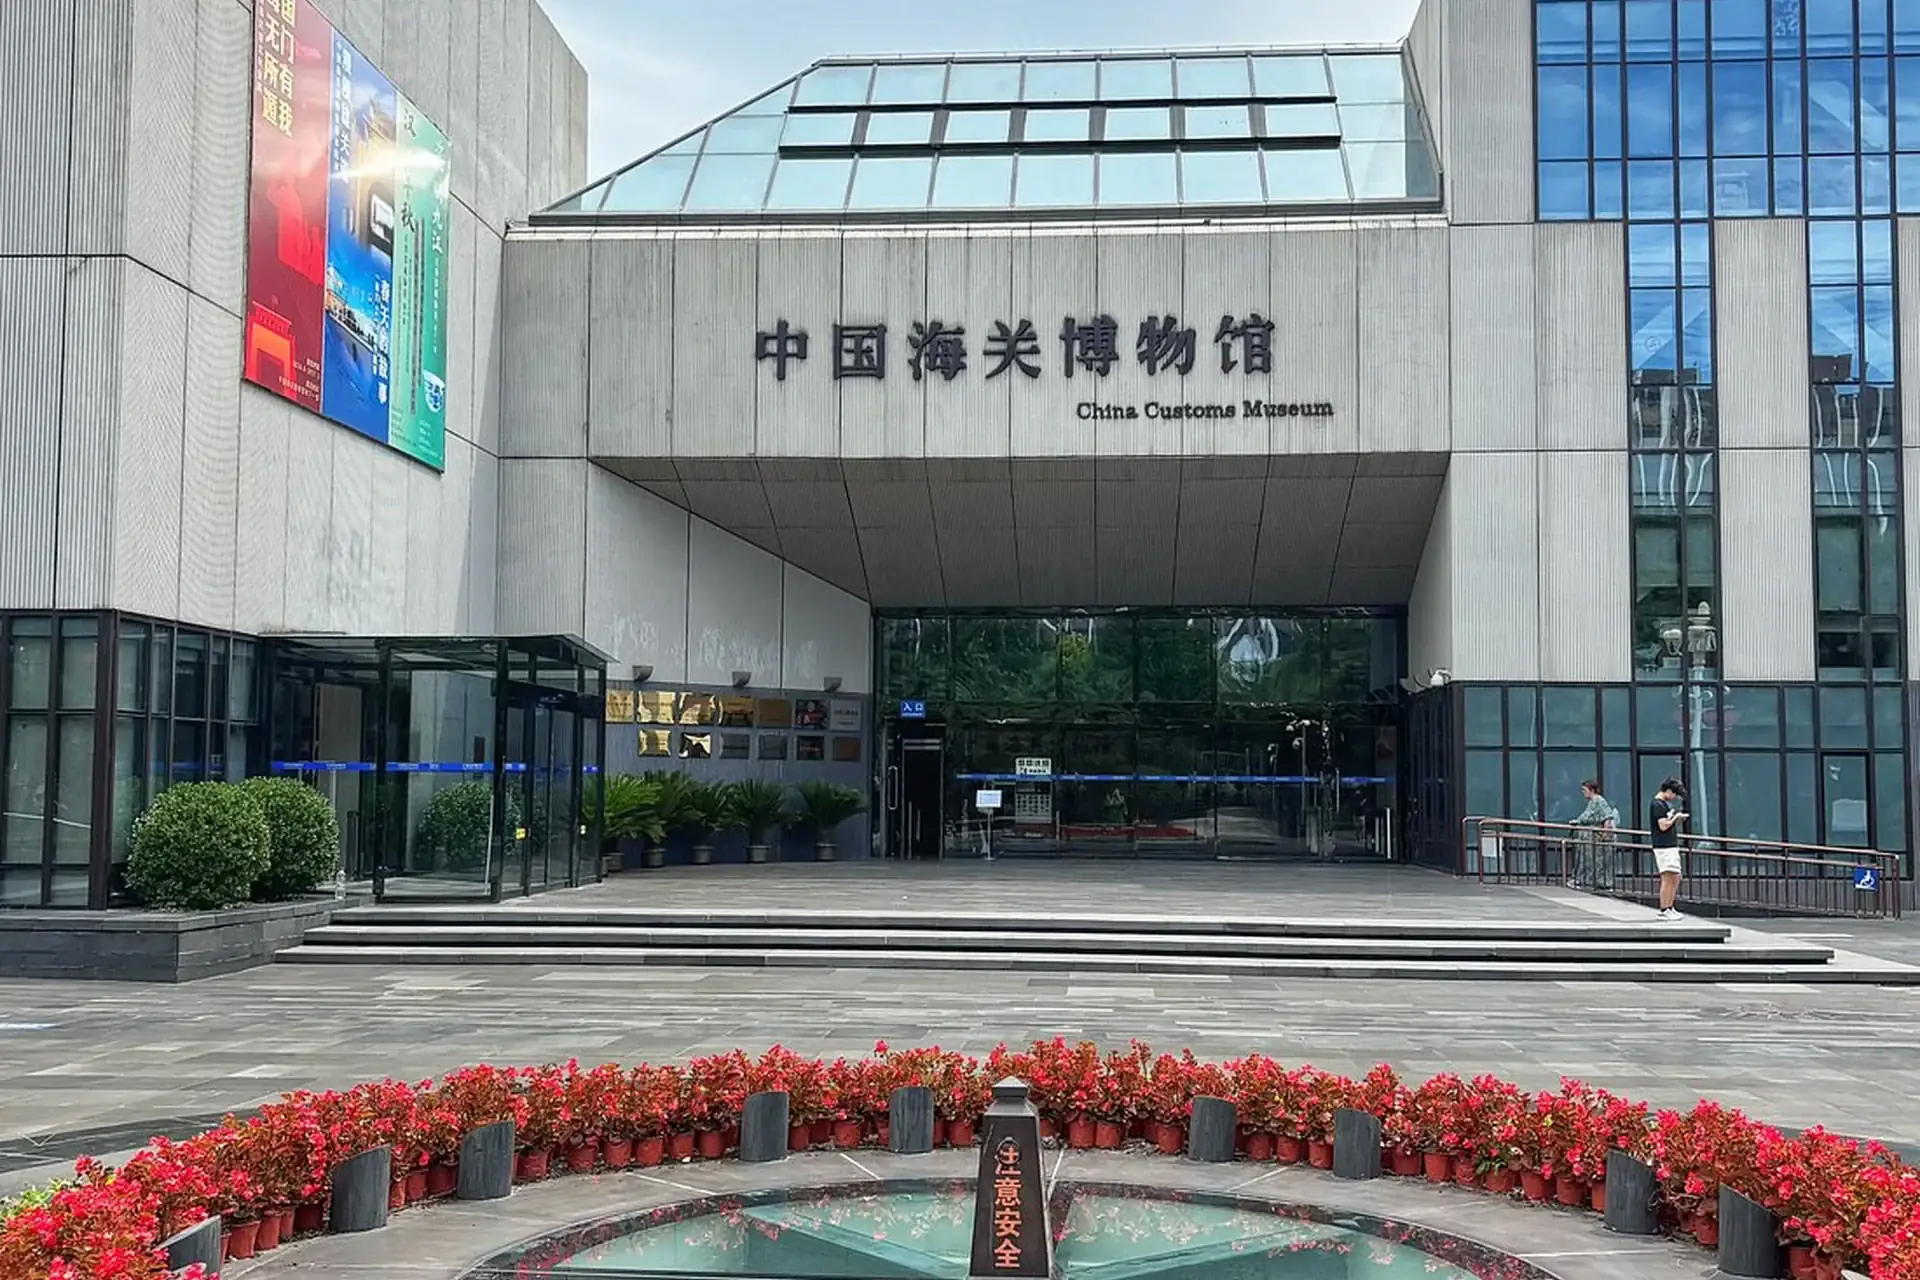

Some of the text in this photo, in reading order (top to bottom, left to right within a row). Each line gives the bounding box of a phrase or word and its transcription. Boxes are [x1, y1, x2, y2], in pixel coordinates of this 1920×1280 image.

[756, 313, 1276, 381] 中国海关博物馆
[1076, 400, 1334, 420] China Customs Museum
[903, 702, 923, 712] 入口
[994, 1140, 1022, 1269] 注意安全
